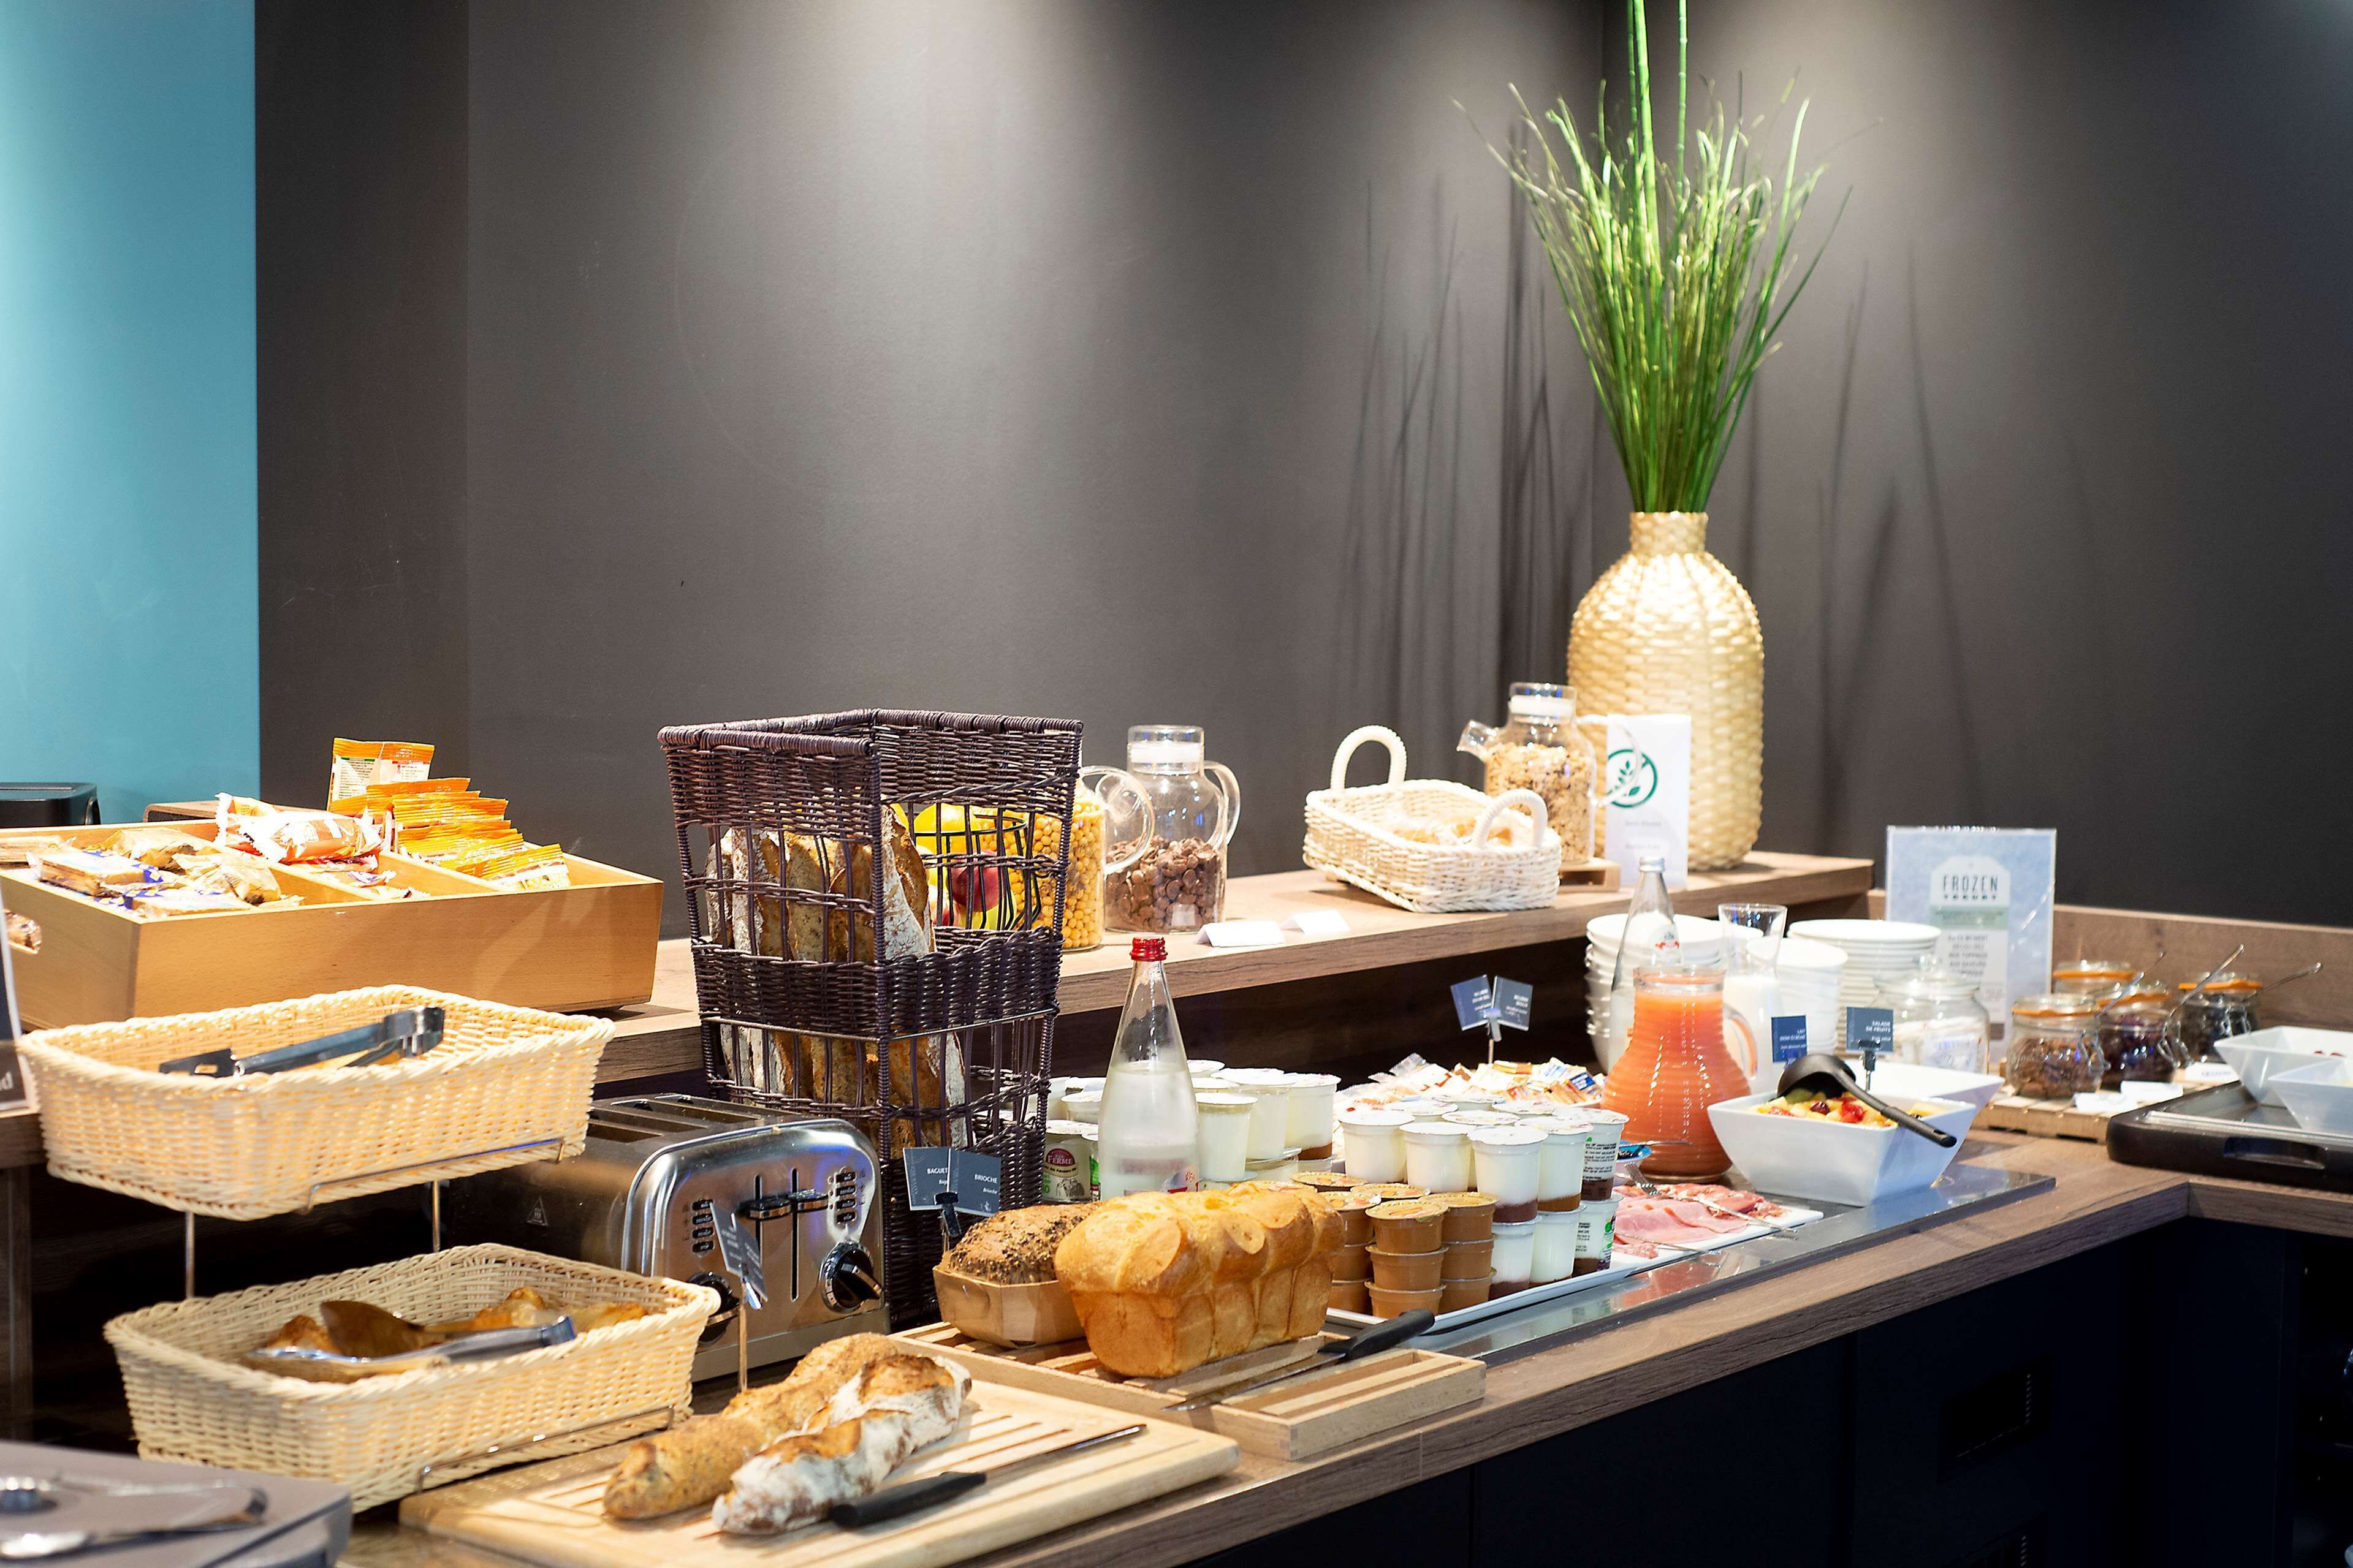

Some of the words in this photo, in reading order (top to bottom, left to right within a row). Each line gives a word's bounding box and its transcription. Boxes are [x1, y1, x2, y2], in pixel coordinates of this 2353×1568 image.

[1944, 875, 1998, 892] FROZEN
[1048, 1156, 1073, 1164] FERME
[975, 1174, 998, 1183] BRIOCHE
